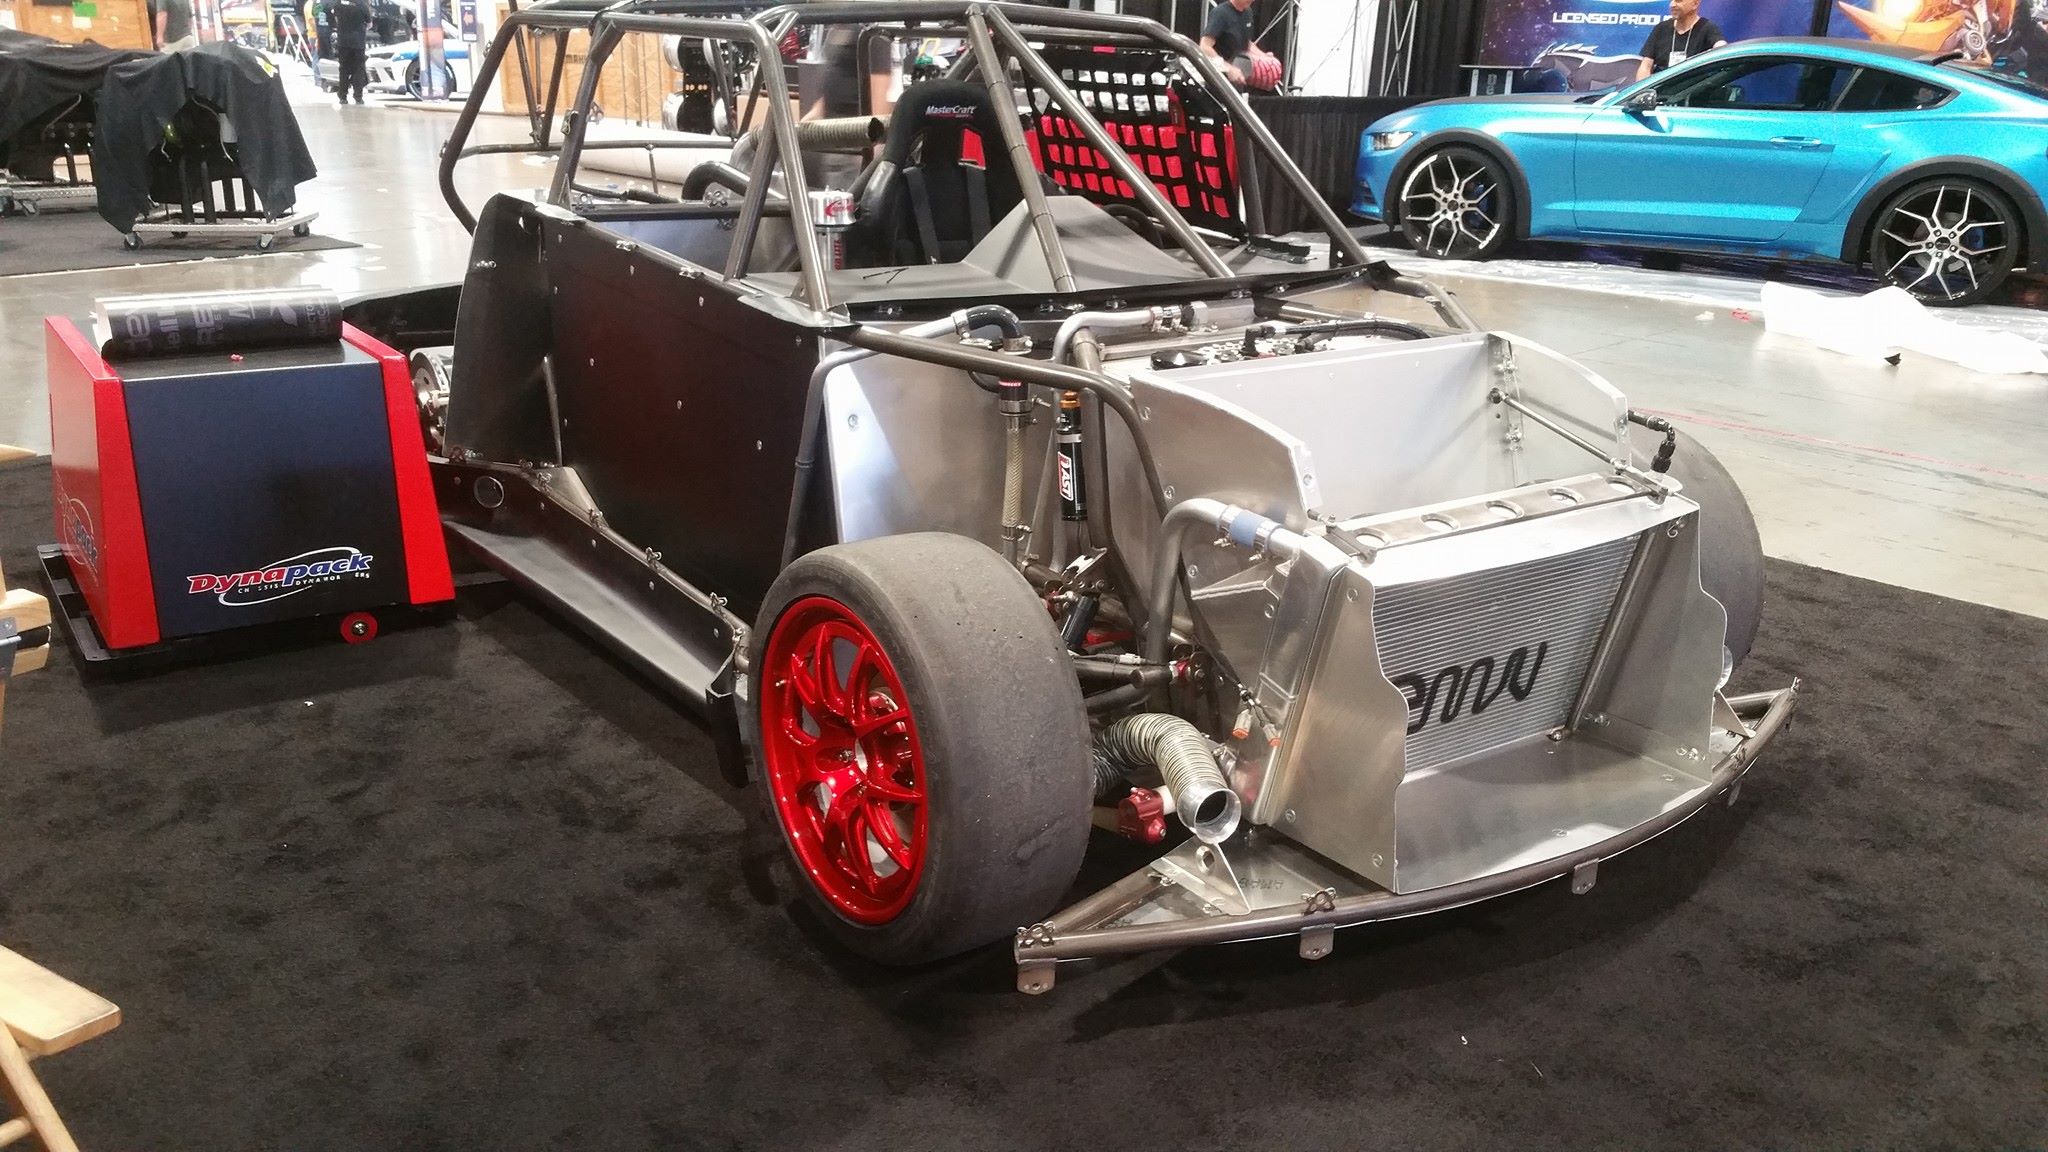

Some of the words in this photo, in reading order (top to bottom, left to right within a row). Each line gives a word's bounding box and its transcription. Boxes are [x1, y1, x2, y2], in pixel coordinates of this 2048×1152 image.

[1552, 12, 1618, 25] LICENSED
[1619, 14, 1673, 25] PRODU
[925, 105, 977, 115] MasterCraft
[187, 553, 374, 594] Dynapack
[237, 583, 279, 594] CHSSIS
